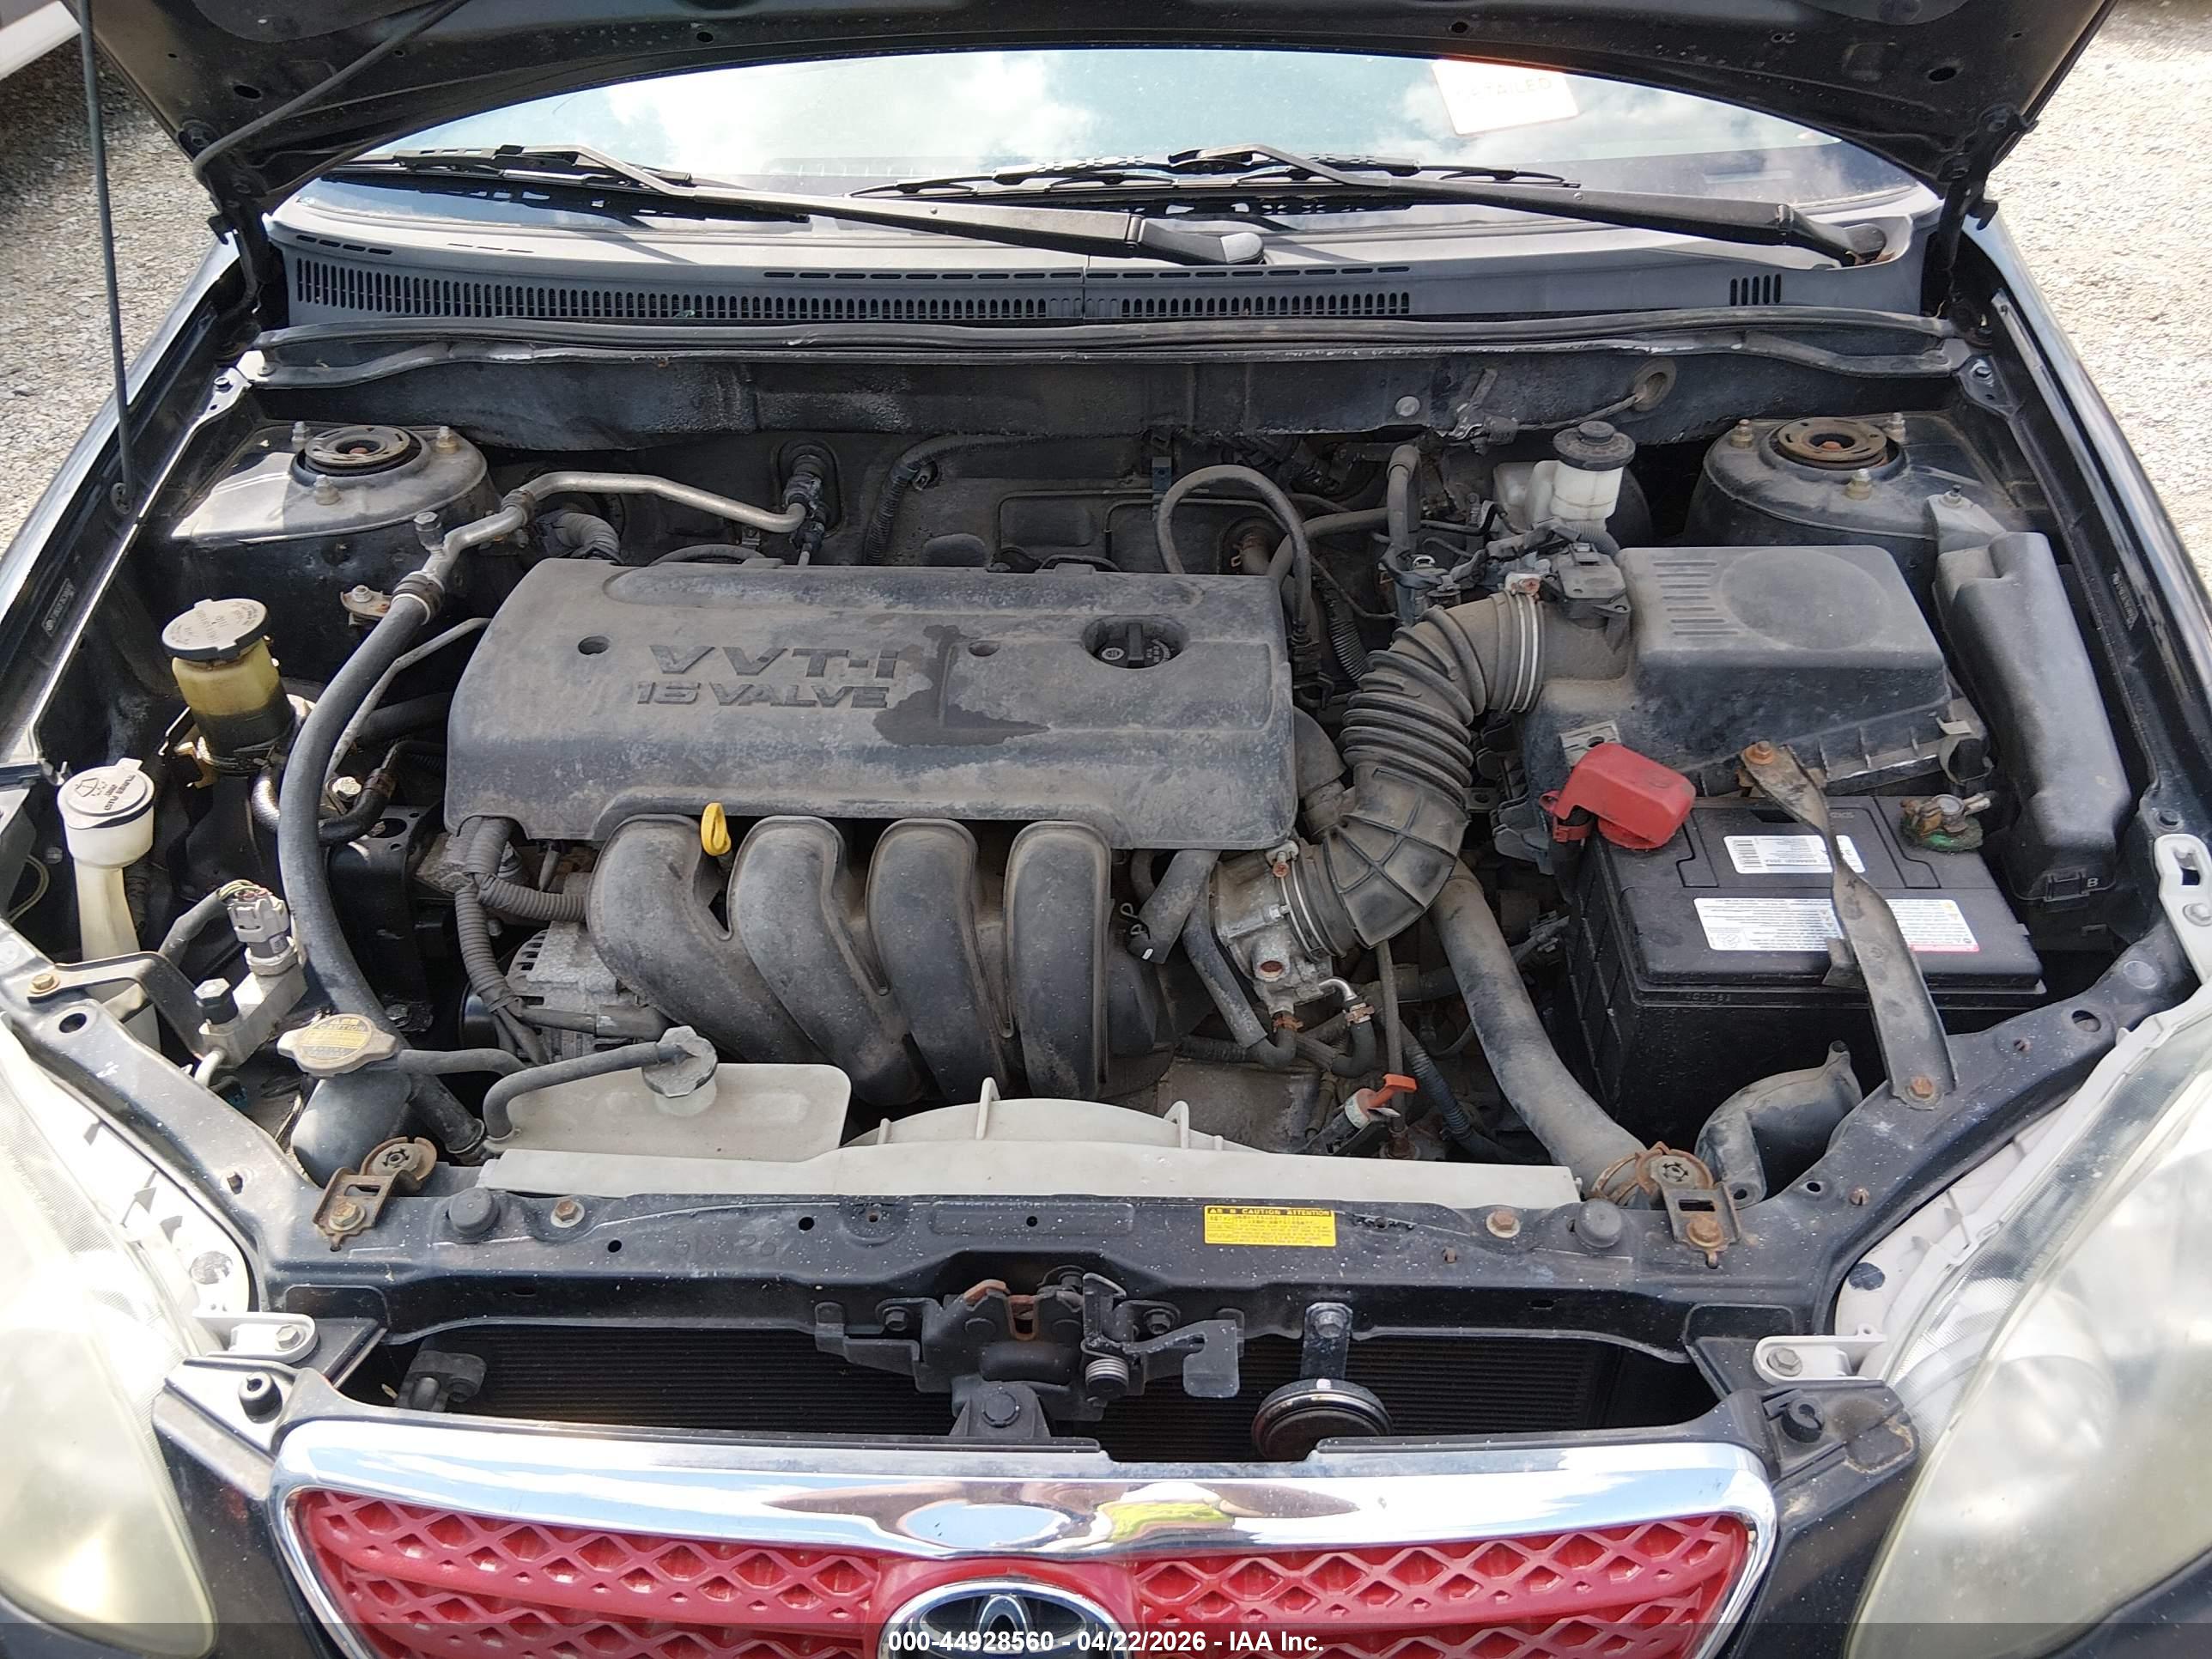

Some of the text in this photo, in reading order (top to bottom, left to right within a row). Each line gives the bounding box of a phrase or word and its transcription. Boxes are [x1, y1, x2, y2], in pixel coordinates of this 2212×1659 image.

[637, 682, 889, 708] 16 VALVE
[2087, 878, 2099, 888] B
